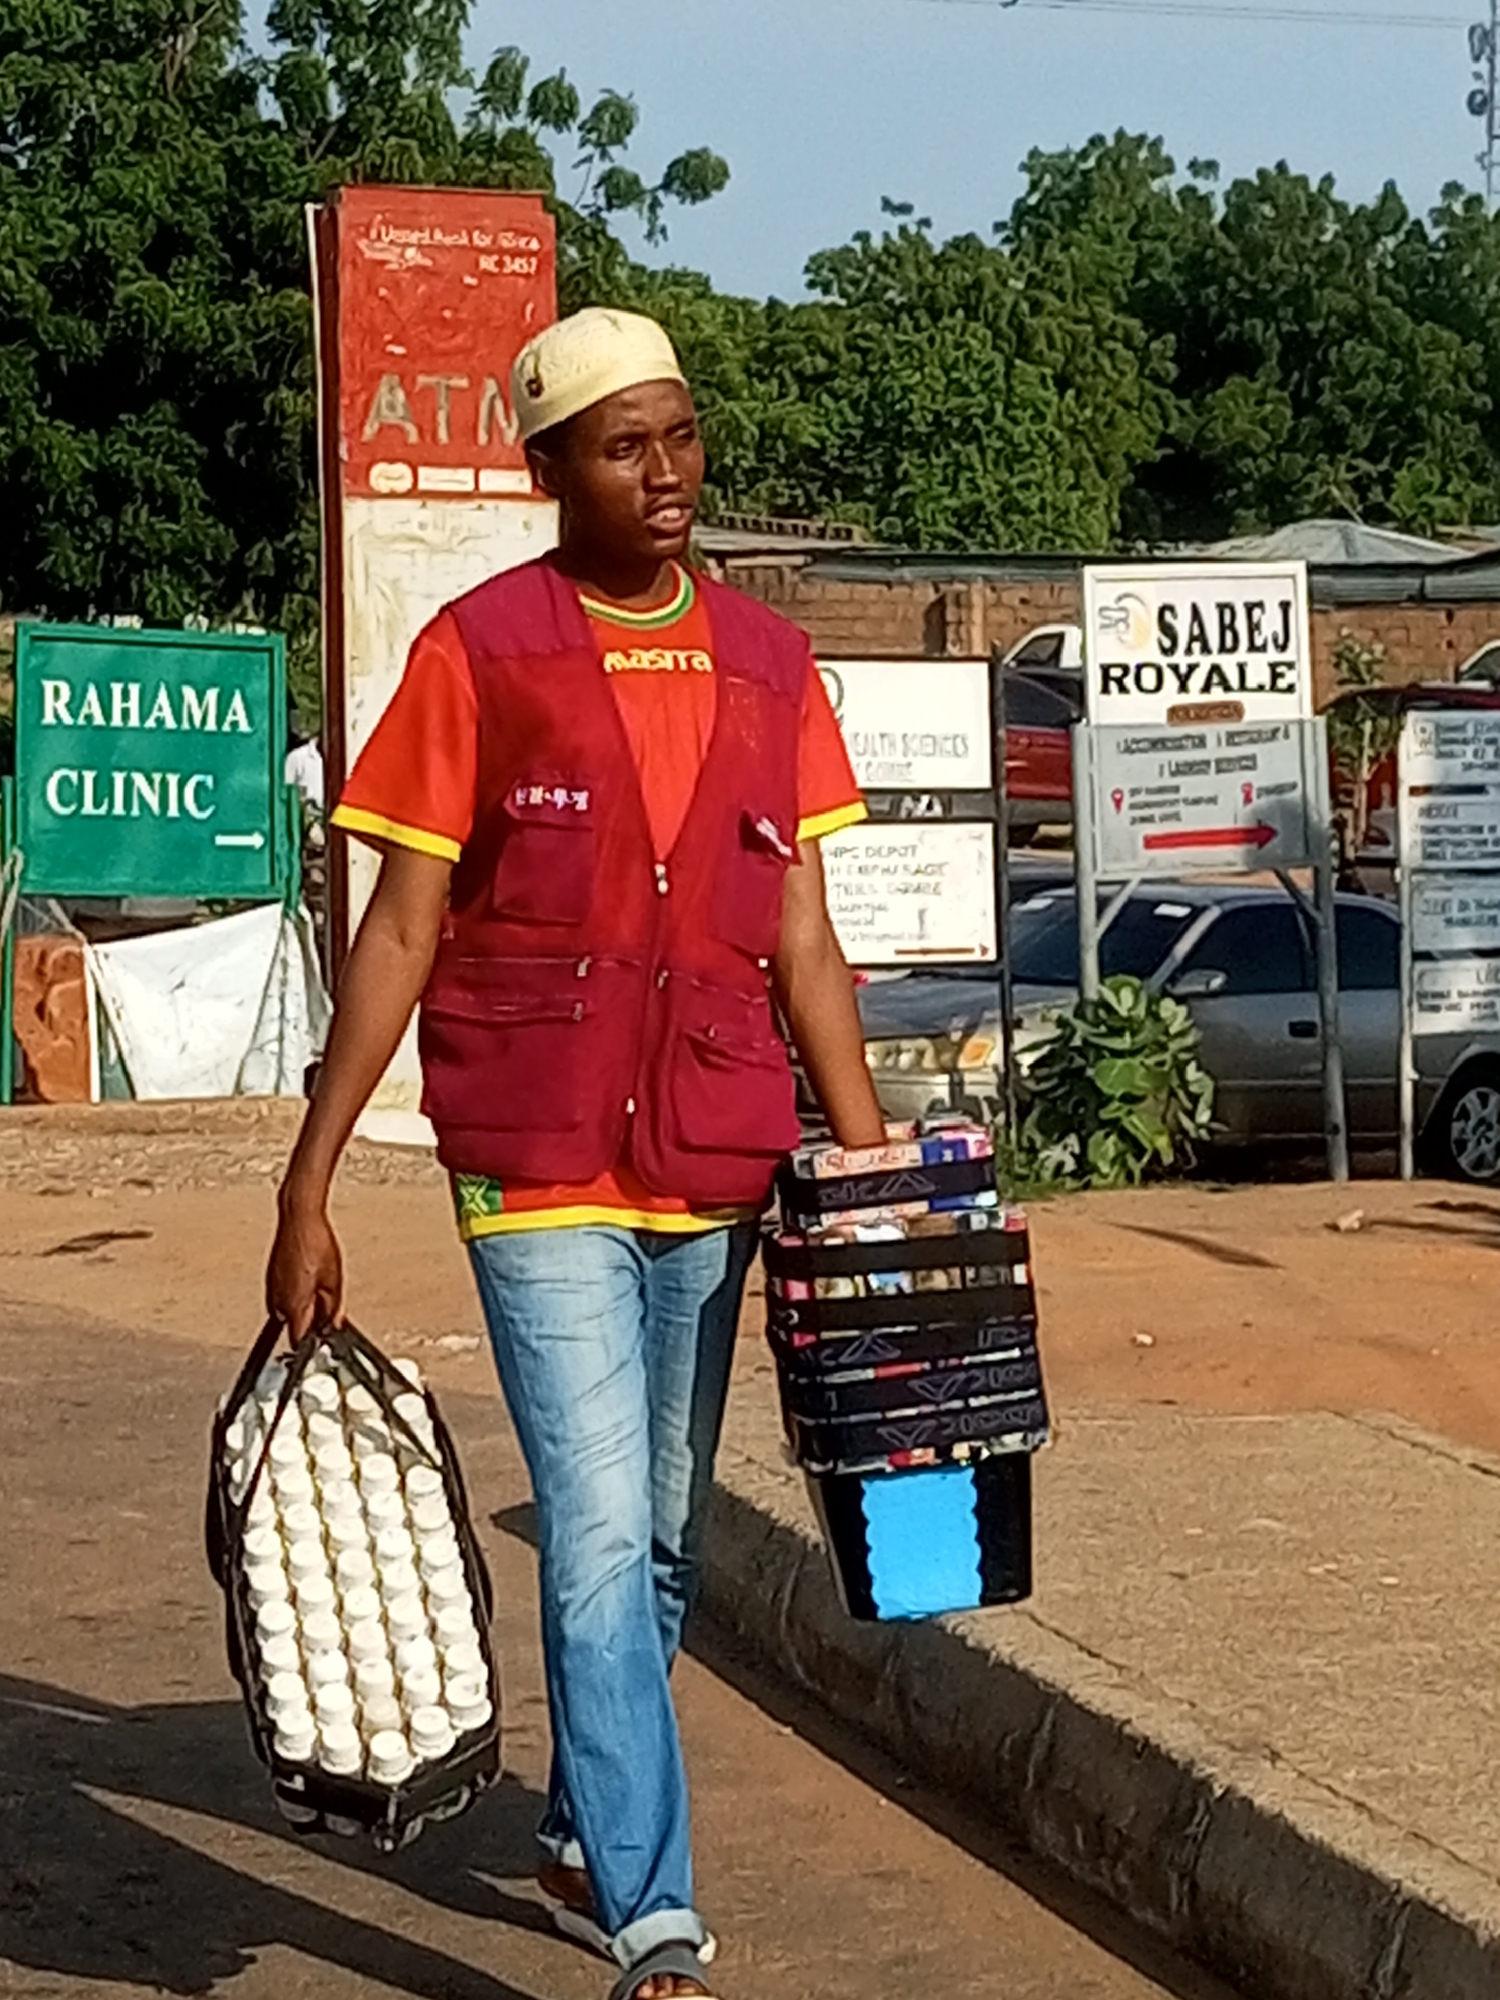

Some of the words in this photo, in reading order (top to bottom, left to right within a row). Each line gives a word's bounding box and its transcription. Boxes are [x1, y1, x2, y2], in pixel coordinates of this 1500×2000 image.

[1157, 600, 1292, 657] SABEJ
[1099, 661, 1296, 695] ROYALE
[40, 679, 253, 733] RAHAMA
[46, 768, 216, 820] CLINIC
